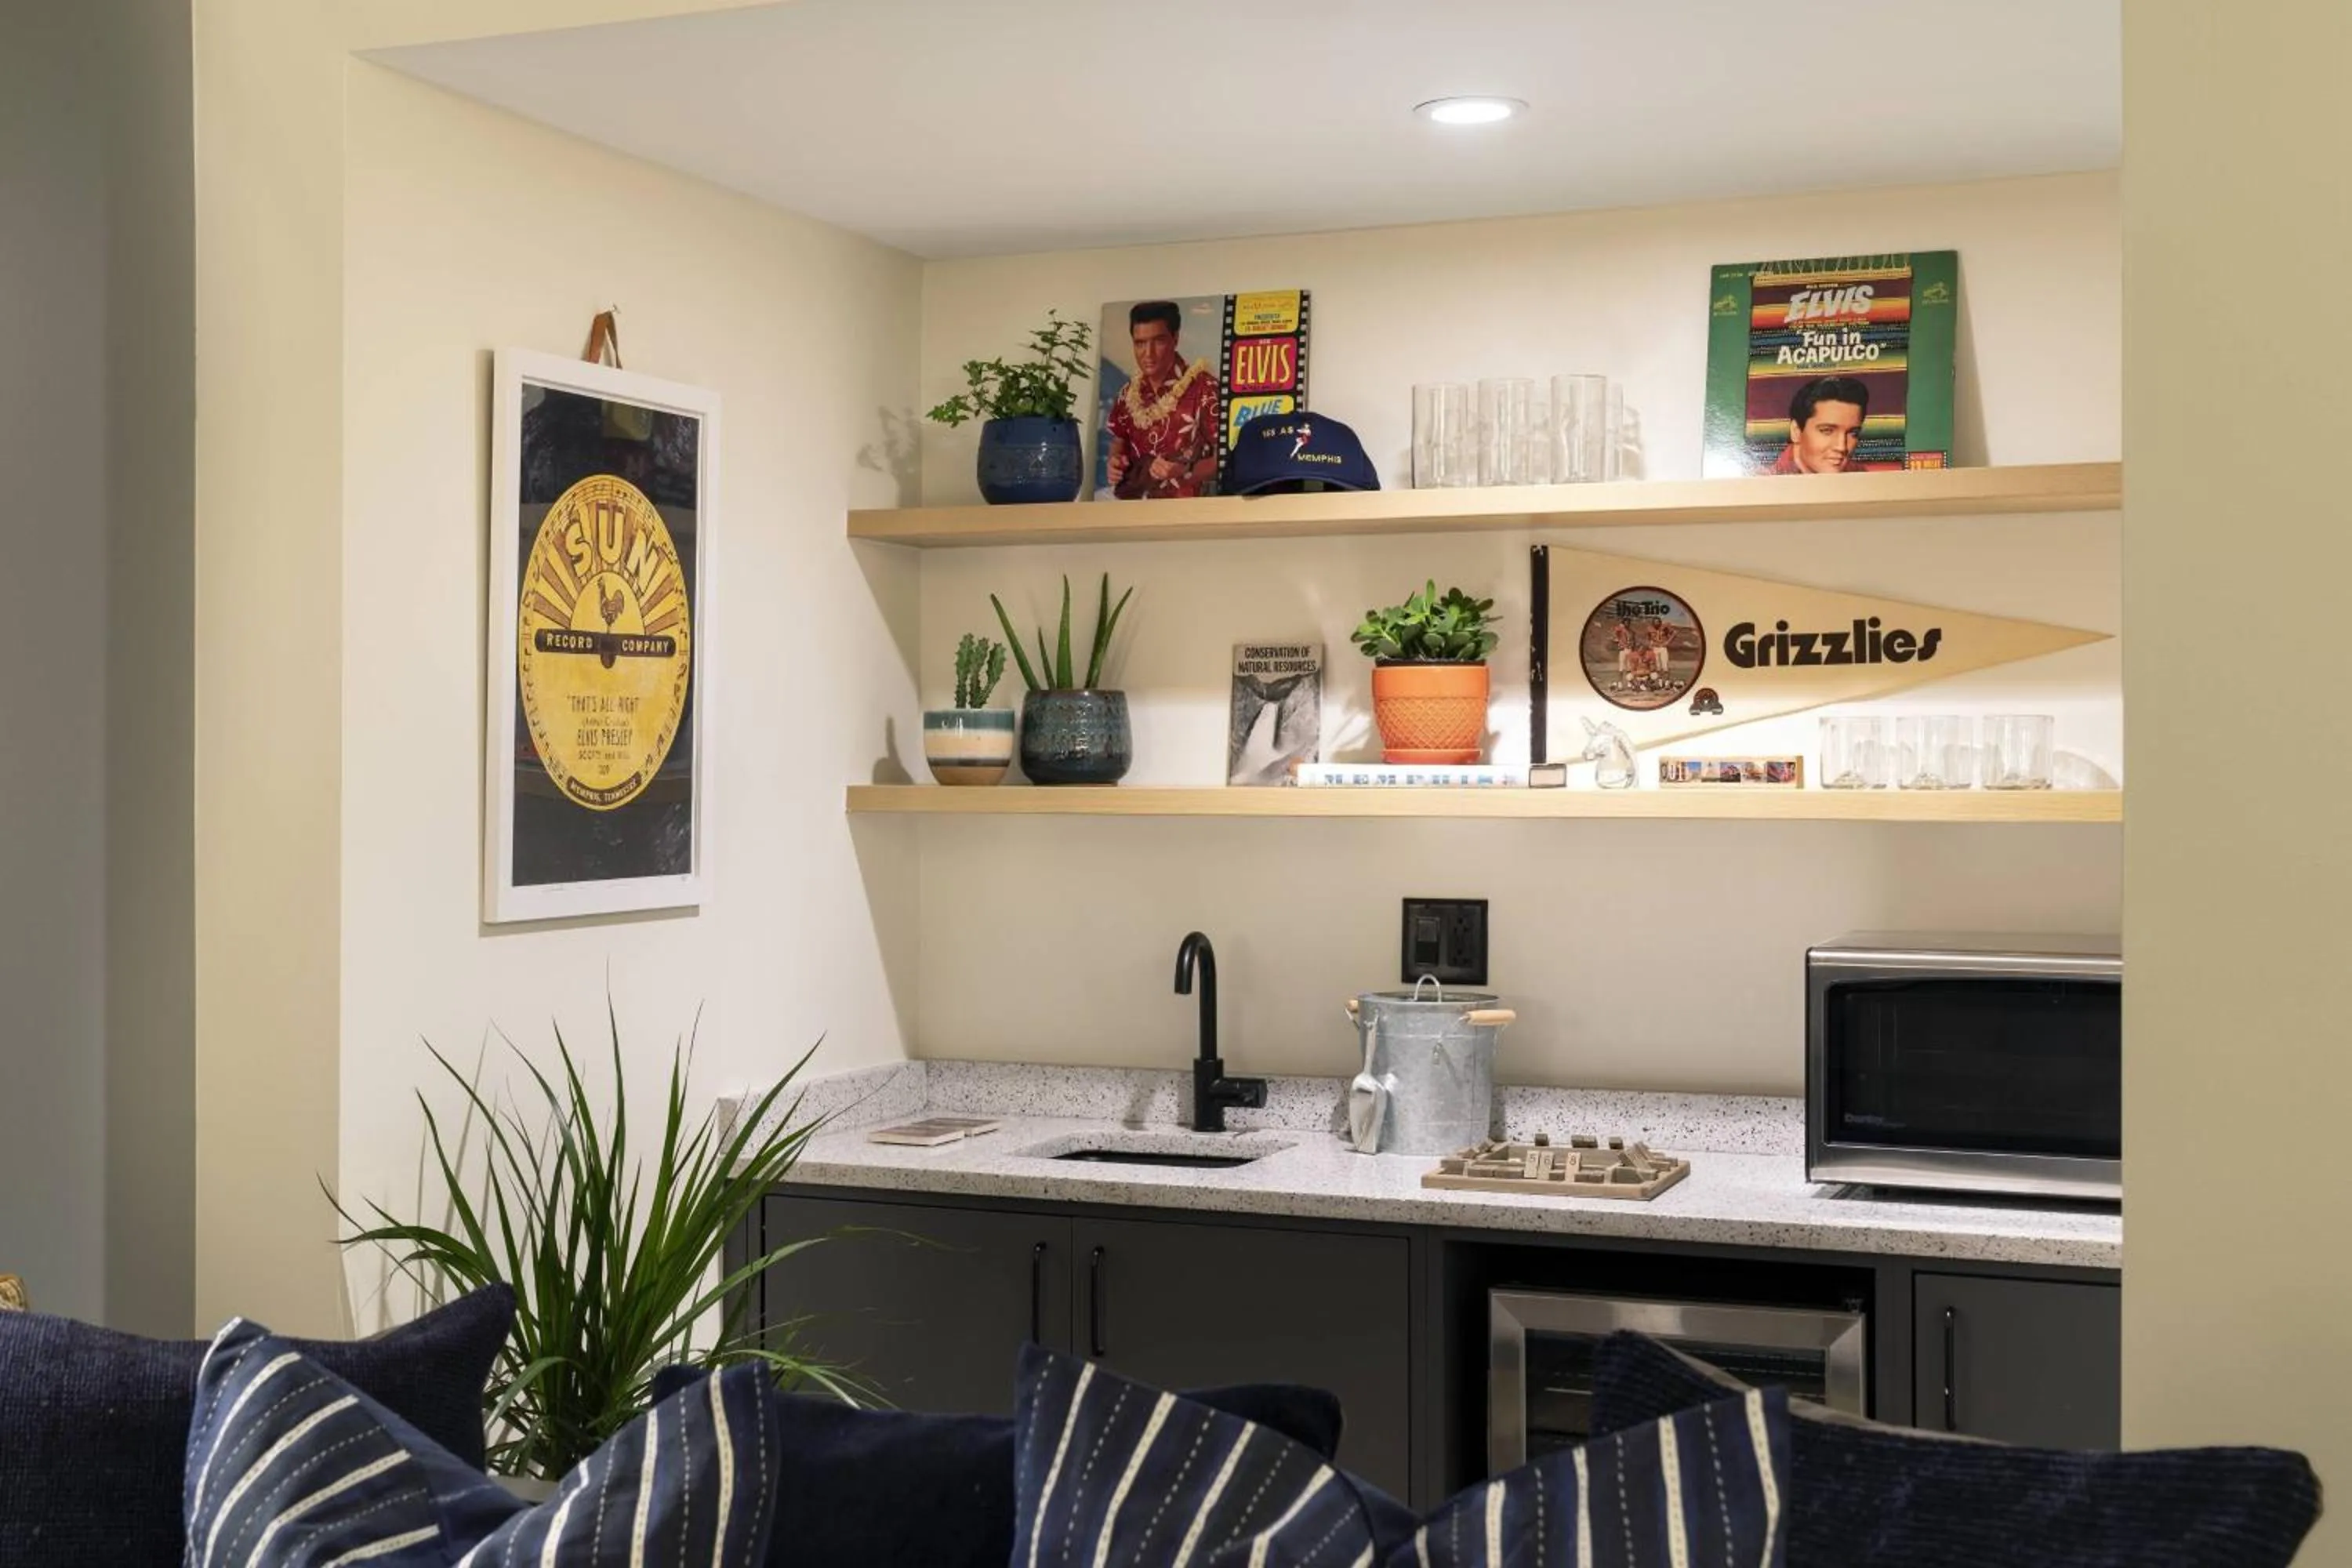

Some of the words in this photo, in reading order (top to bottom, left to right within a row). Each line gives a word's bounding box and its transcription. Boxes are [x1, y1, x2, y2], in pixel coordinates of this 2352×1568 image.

[1784, 285, 1874, 323] ELVIS
[1842, 327, 1861, 345] in
[1236, 344, 1290, 384] ELVIS
[563, 503, 660, 594] SUN
[1641, 601, 1671, 615] Trio
[546, 633, 593, 649] RECORD
[622, 640, 669, 653] COMPANY
[1244, 646, 1300, 659] CONSERVATION
[1301, 645, 1311, 657] OF
[1723, 617, 1942, 668] Grizzlies
[1238, 661, 1272, 673] NATURAL
[1273, 660, 1316, 673] RESOURCES
